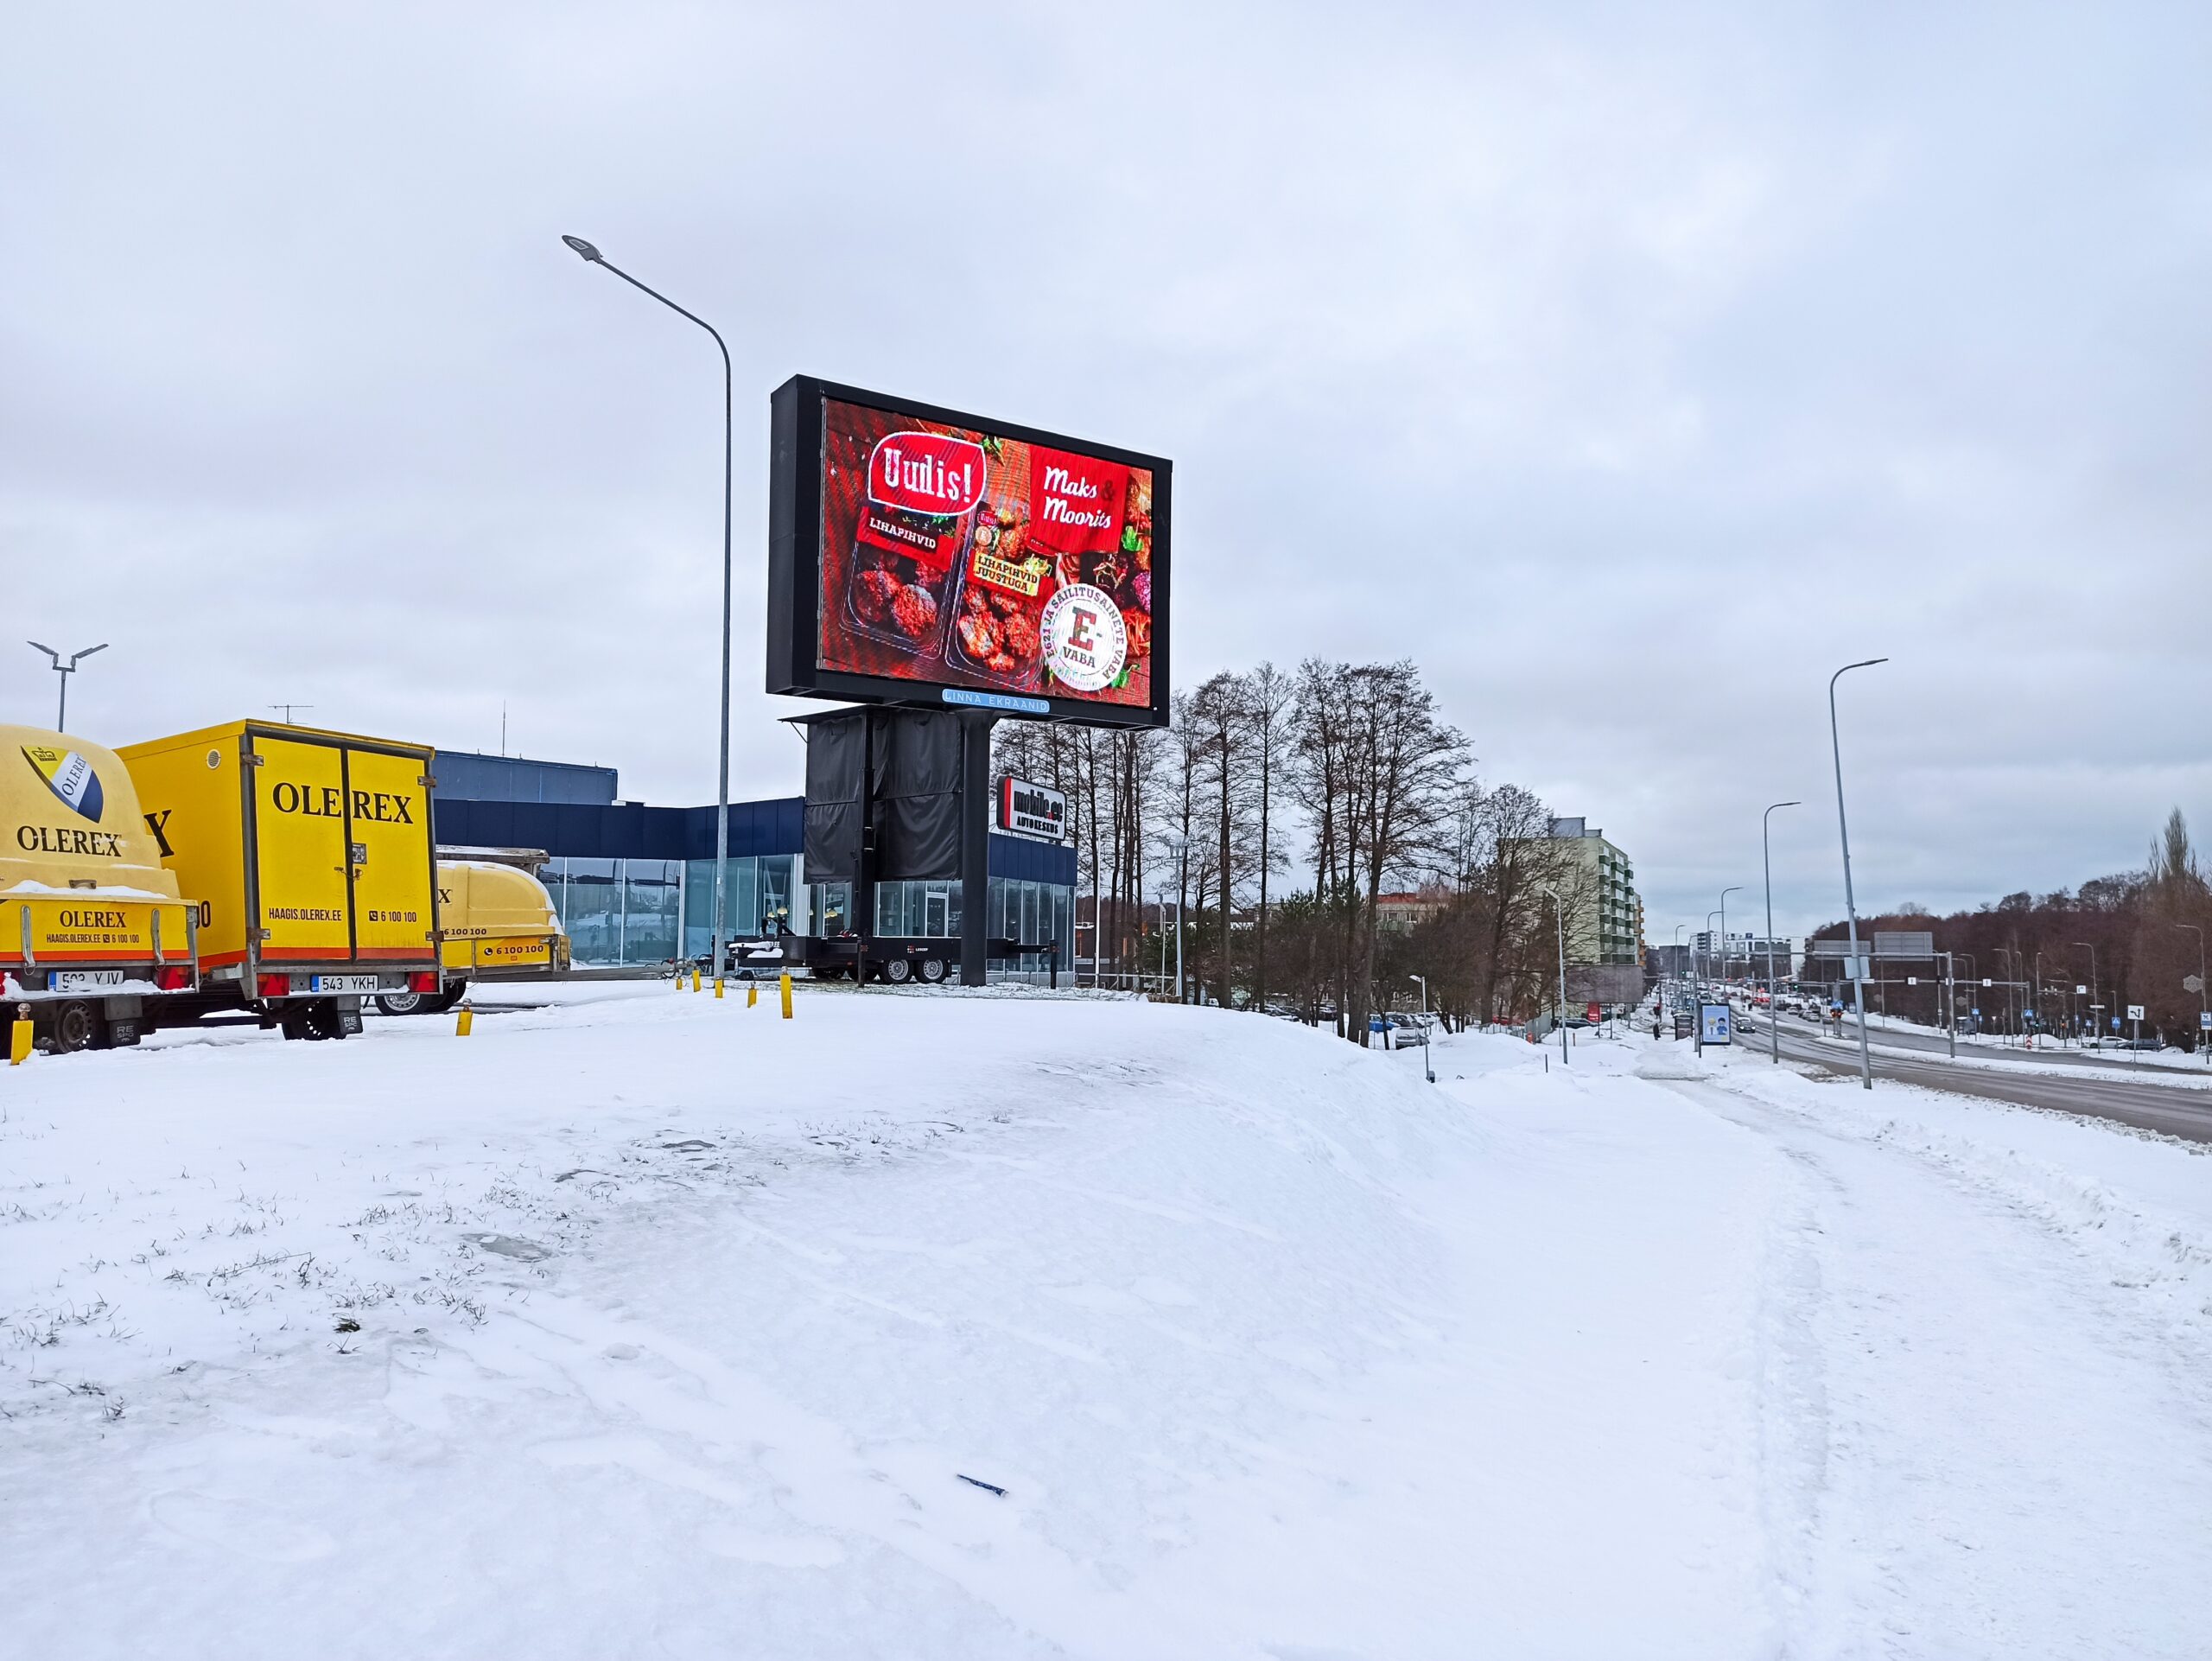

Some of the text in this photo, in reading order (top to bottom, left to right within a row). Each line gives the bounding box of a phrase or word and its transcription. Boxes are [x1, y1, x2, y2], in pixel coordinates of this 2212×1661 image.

[883, 448, 971, 503] Uudis!
[1043, 465, 1097, 499] Maks
[1043, 496, 1112, 529] Moorits
[869, 517, 937, 550] LIHAPIHVID
[976, 566, 1028, 592] JUUSTUGA
[978, 555, 1038, 584] LIHAPIHVID
[1062, 646, 1096, 668] VABA
[944, 690, 1047, 711] LINNA EKRAANID
[273, 781, 414, 824] OLEREX
[1014, 788, 1064, 823] mobile.ee
[1016, 815, 1058, 835] AUTOKESKUS
[16, 825, 123, 858] OLEREX
[60, 910, 127, 928] OLEREX
[269, 907, 417, 923] HAAGIS.OLEREX.EE 6 100 100
[46, 933, 140, 944] HAAGIS.OLEREX.EE 6 100 100
[496, 945, 544, 955] 6 100 100
[322, 977, 344, 990] 543
[351, 977, 375, 990] YKH
